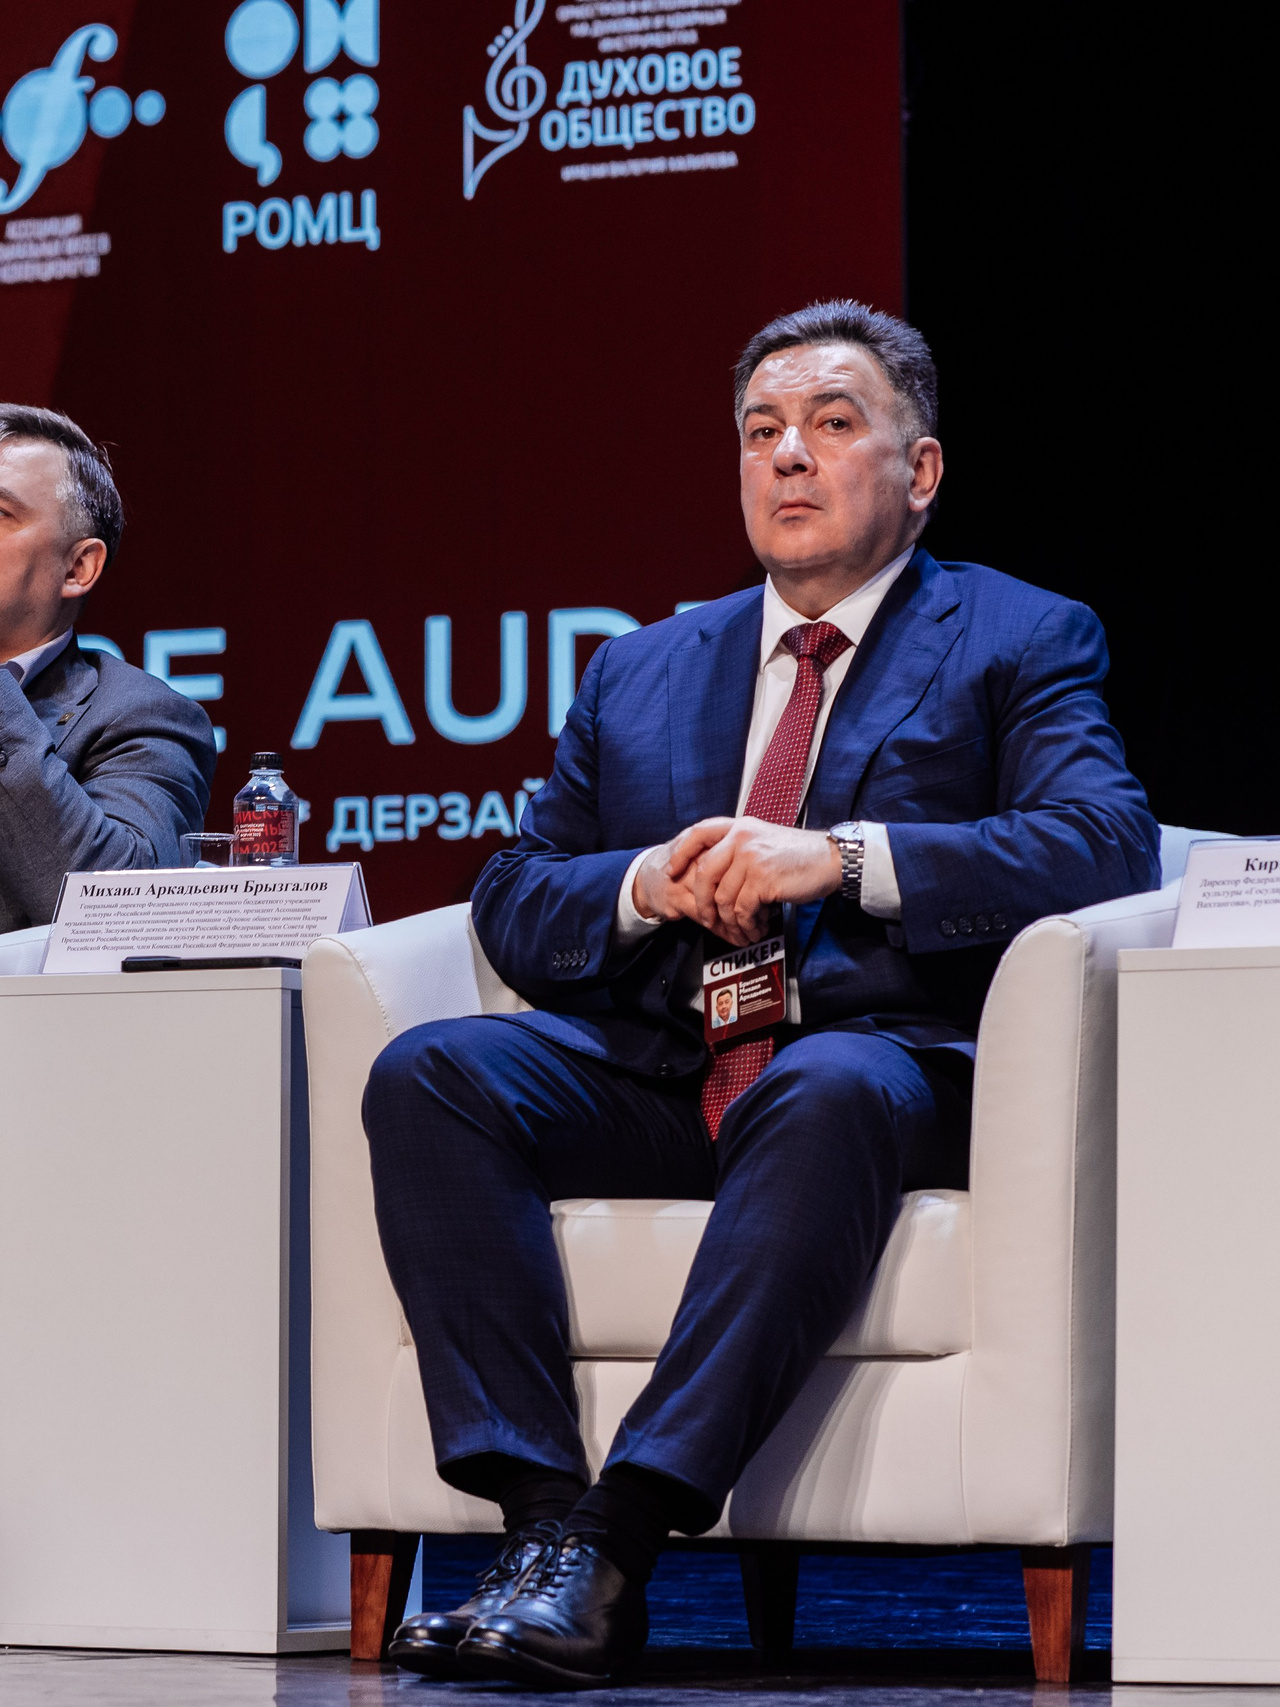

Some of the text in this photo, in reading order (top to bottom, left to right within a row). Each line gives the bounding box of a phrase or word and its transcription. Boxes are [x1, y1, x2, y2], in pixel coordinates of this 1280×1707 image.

[556, 46, 743, 109] ДУХОВОЕ
[539, 93, 756, 151] ОБЩЕСТВО
[222, 188, 381, 254] РОМЦ
[1245, 858, 1280, 873] Кир
[80, 880, 328, 899] Михаил Аркадьевич Брызгалов
[1200, 879, 1241, 888] Директор
[189, 899, 242, 907] государственного
[243, 898, 284, 906] бюджетного
[284, 898, 321, 906] учреждения
[1202, 889, 1243, 899] культуры
[710, 940, 780, 977] СПИКЕР
